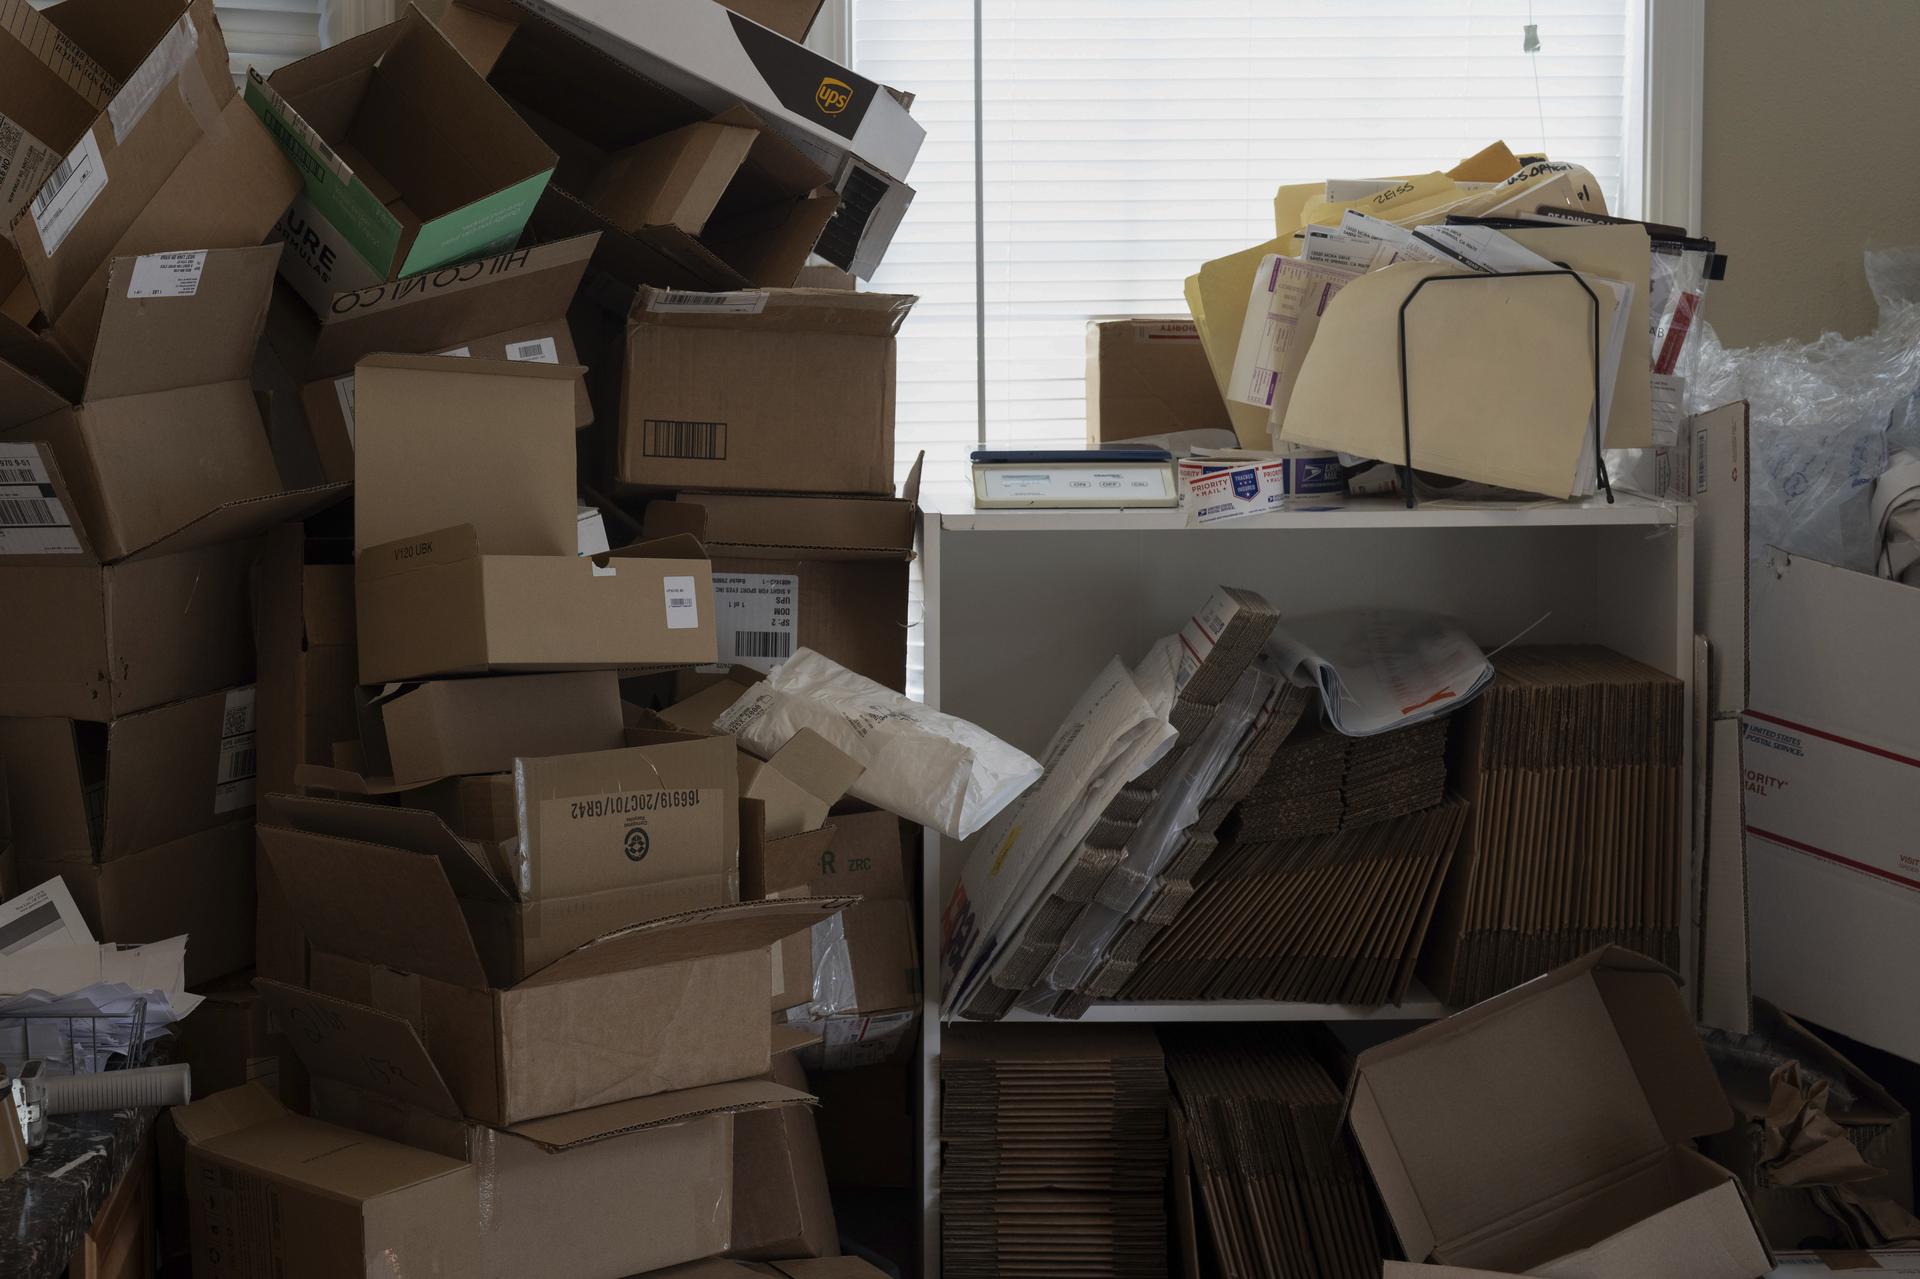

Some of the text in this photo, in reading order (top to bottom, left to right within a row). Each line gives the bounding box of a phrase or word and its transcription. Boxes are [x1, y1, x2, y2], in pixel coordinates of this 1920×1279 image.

[1373, 182, 1415, 204] ZEISS
[288, 208, 337, 271] URE
[274, 222, 330, 283] ORMULAS
[1160, 324, 1197, 333] RIORITY
[1191, 478, 1228, 492] PRIORITY
[1201, 488, 1221, 497] MAIL
[775, 596, 790, 605] UPS
[773, 607, 790, 616] DOM
[1746, 734, 1772, 747] POSTAL
[1749, 725, 1801, 746] UNITED STATES
[1745, 768, 1785, 790] IORITY
[821, 850, 836, 874] R
